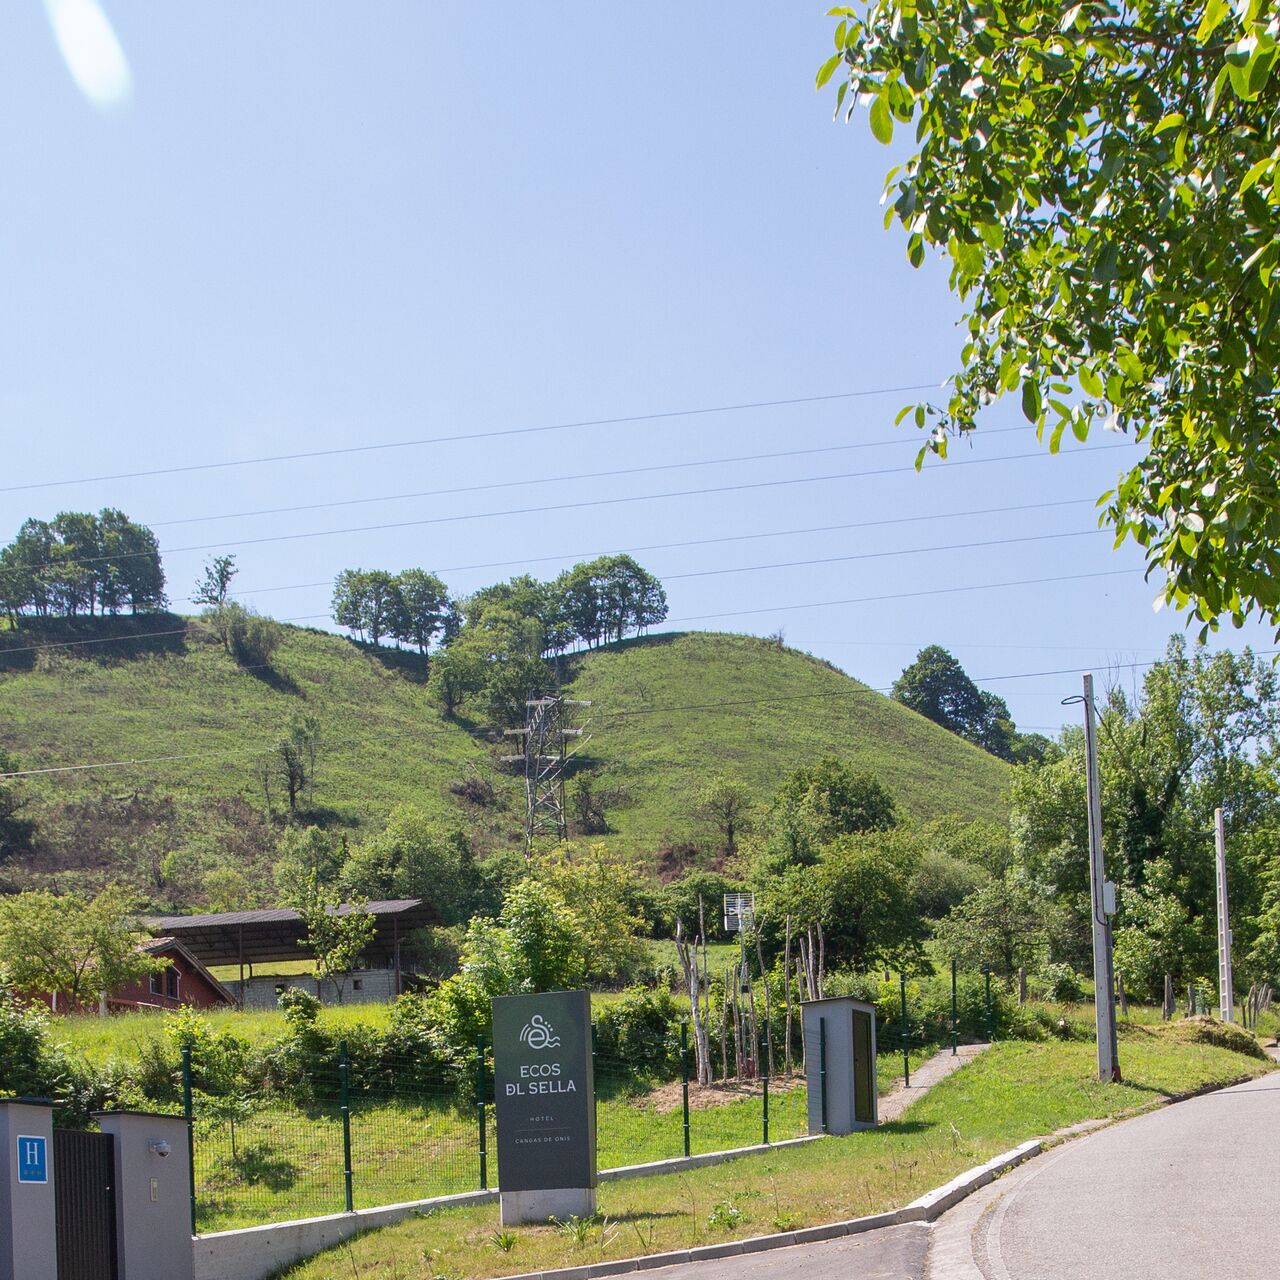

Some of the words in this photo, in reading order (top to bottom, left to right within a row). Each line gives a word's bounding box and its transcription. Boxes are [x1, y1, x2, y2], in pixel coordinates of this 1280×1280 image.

[520, 1063, 561, 1078] ECOS
[528, 1080, 577, 1095] SELLA
[25, 1141, 40, 1166] H
